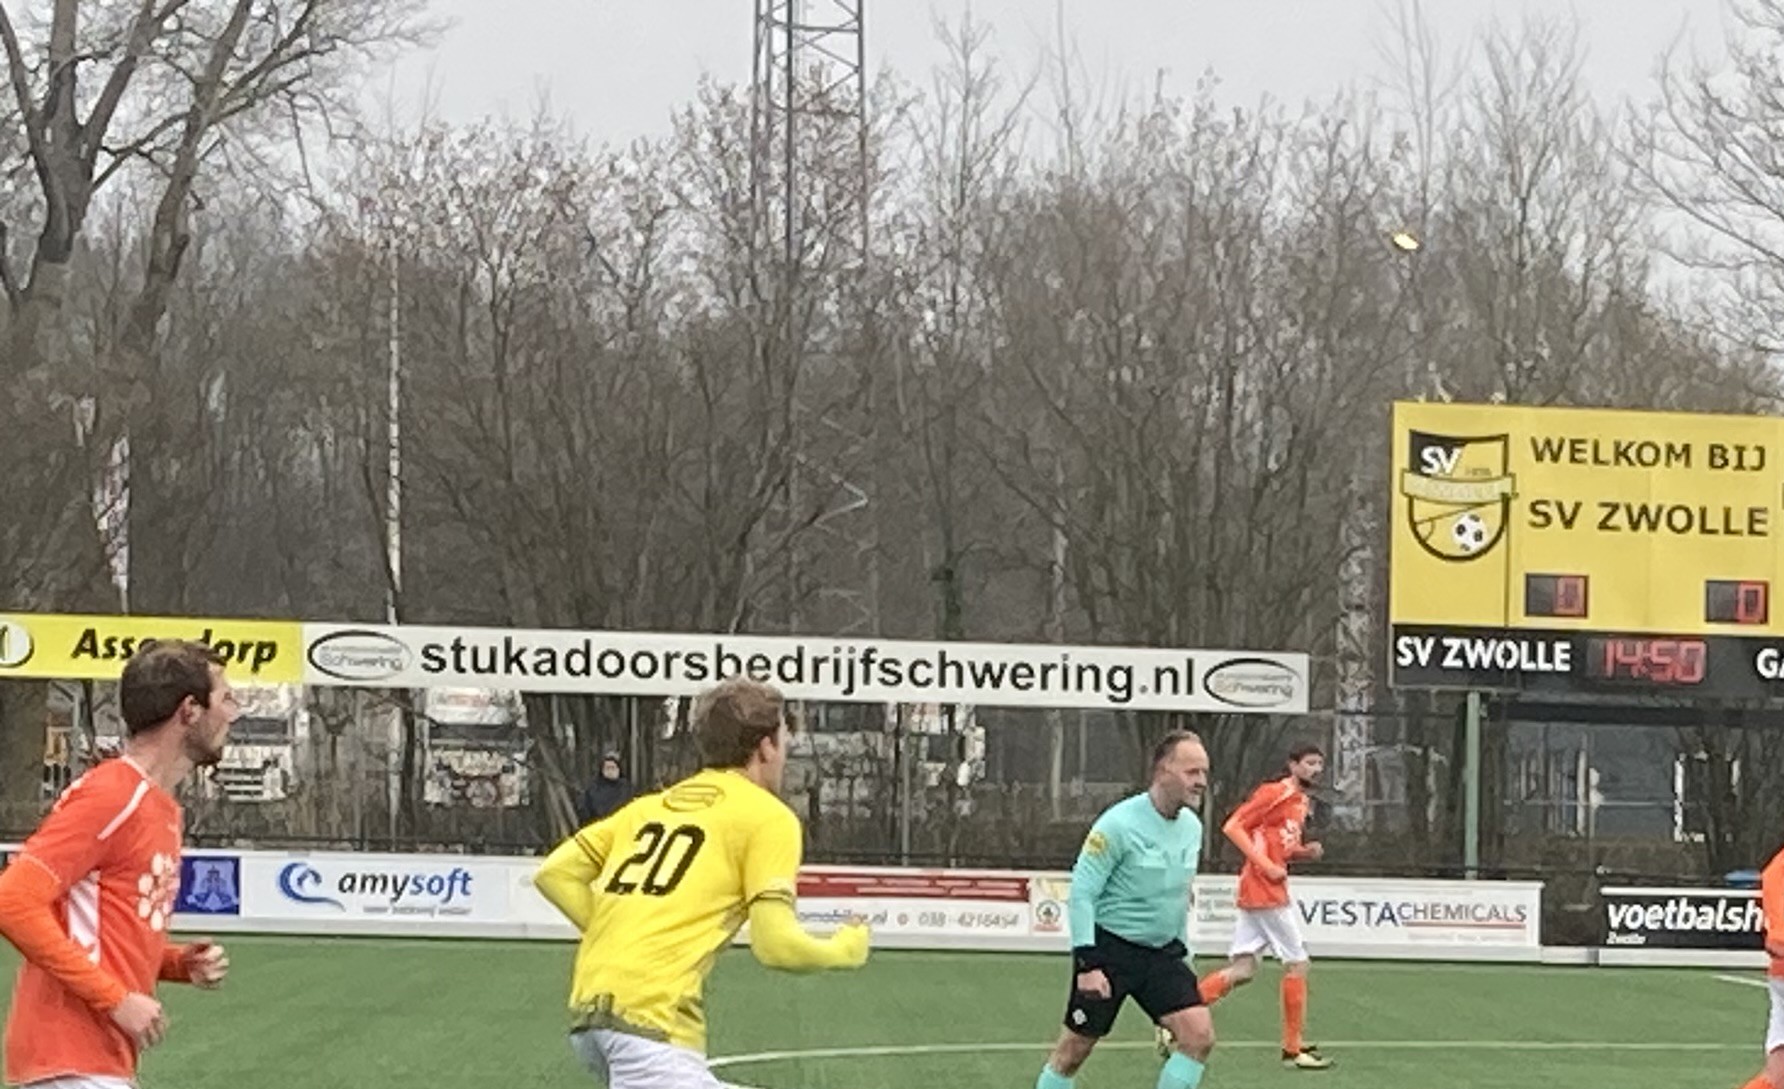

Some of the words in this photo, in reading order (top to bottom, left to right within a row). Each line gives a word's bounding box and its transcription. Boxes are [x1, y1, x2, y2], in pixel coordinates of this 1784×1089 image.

[1420, 445, 1463, 475] SV
[1530, 436, 1692, 468] WELKOM
[1707, 443, 1767, 472] BIJ
[1527, 500, 1583, 529] SV
[1596, 501, 1770, 537] ZWOLLE
[419, 635, 1195, 703] stukadoorsbedrijfschwering.nl
[1395, 635, 1436, 667] SV
[1440, 637, 1572, 672] ZWOLLE
[604, 821, 706, 896] 20
[337, 867, 473, 903] amysoft
